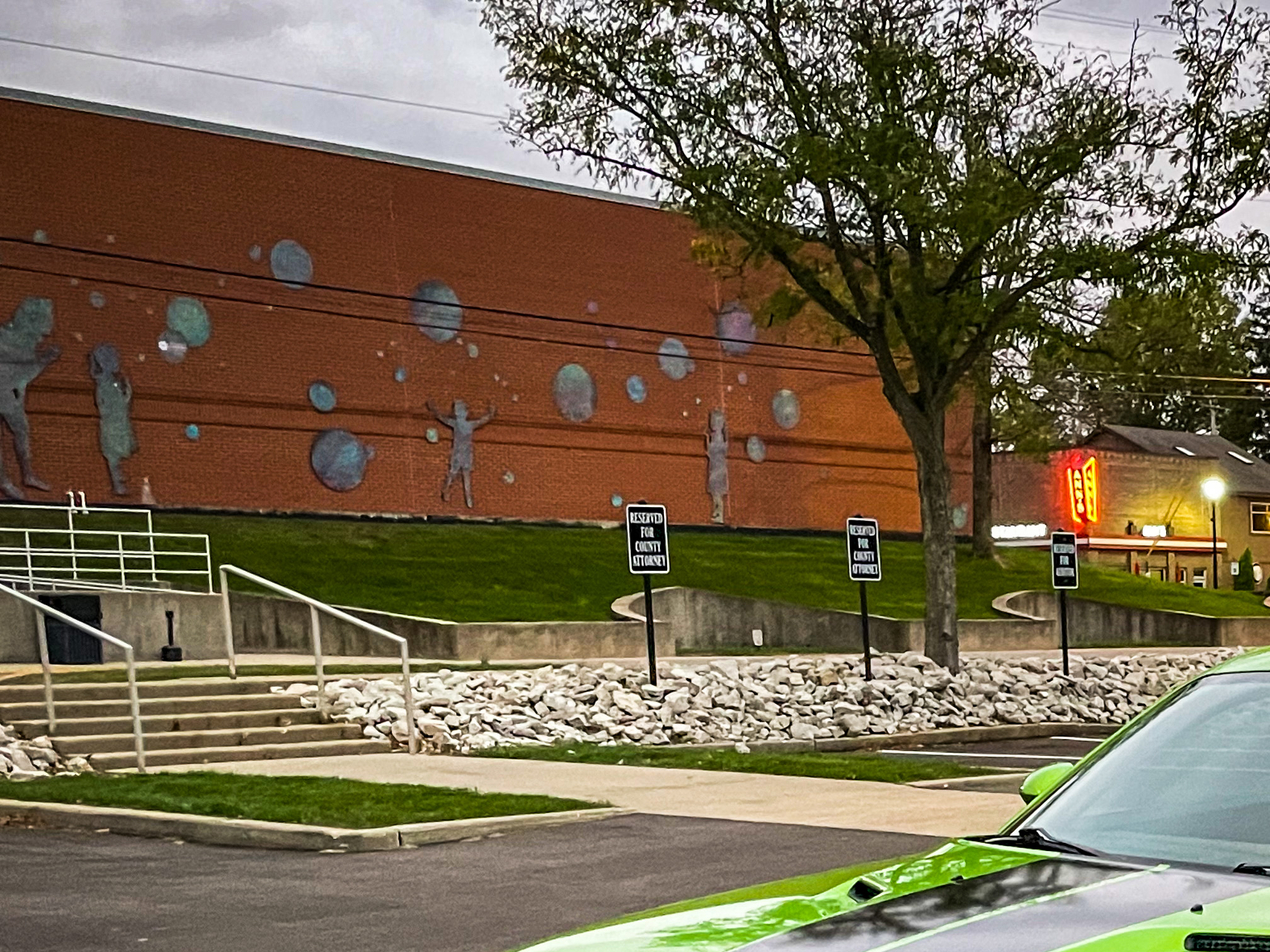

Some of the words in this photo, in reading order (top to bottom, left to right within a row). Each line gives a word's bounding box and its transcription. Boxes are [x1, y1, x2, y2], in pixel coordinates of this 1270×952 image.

[630, 512, 663, 524] RESERVED
[640, 526, 654, 538] FOR
[635, 540, 661, 552] COUNTY
